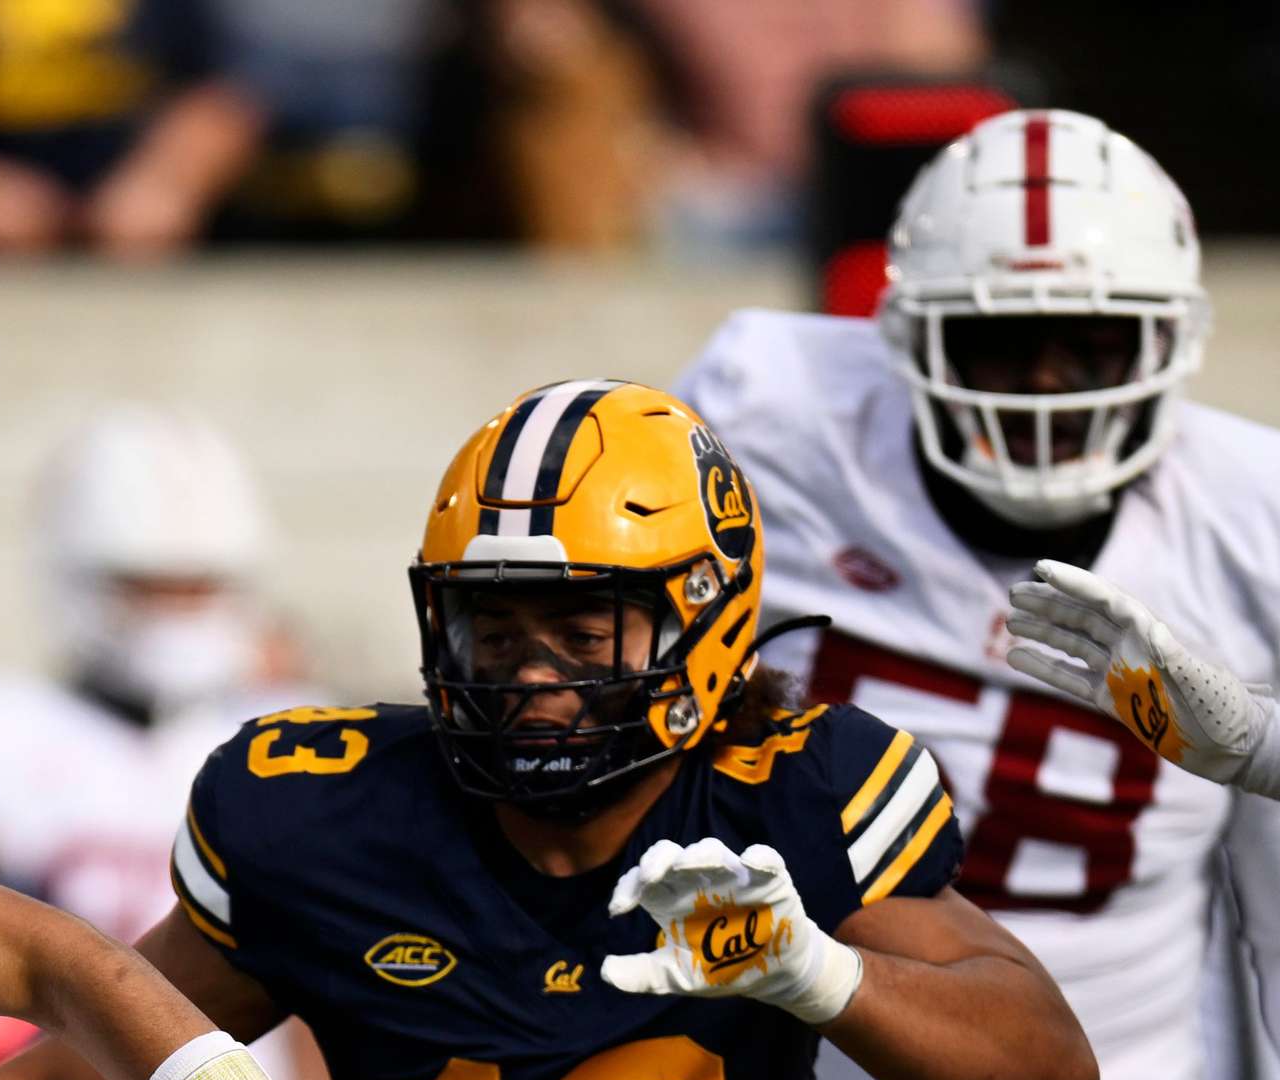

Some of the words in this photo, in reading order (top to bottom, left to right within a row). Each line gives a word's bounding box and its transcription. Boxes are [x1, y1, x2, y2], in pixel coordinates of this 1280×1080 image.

[706, 465, 749, 532] Cal
[1131, 679, 1169, 751] Cal
[381, 946, 441, 966] ACC
[701, 910, 765, 973] Cal
[543, 960, 583, 993] Cal
